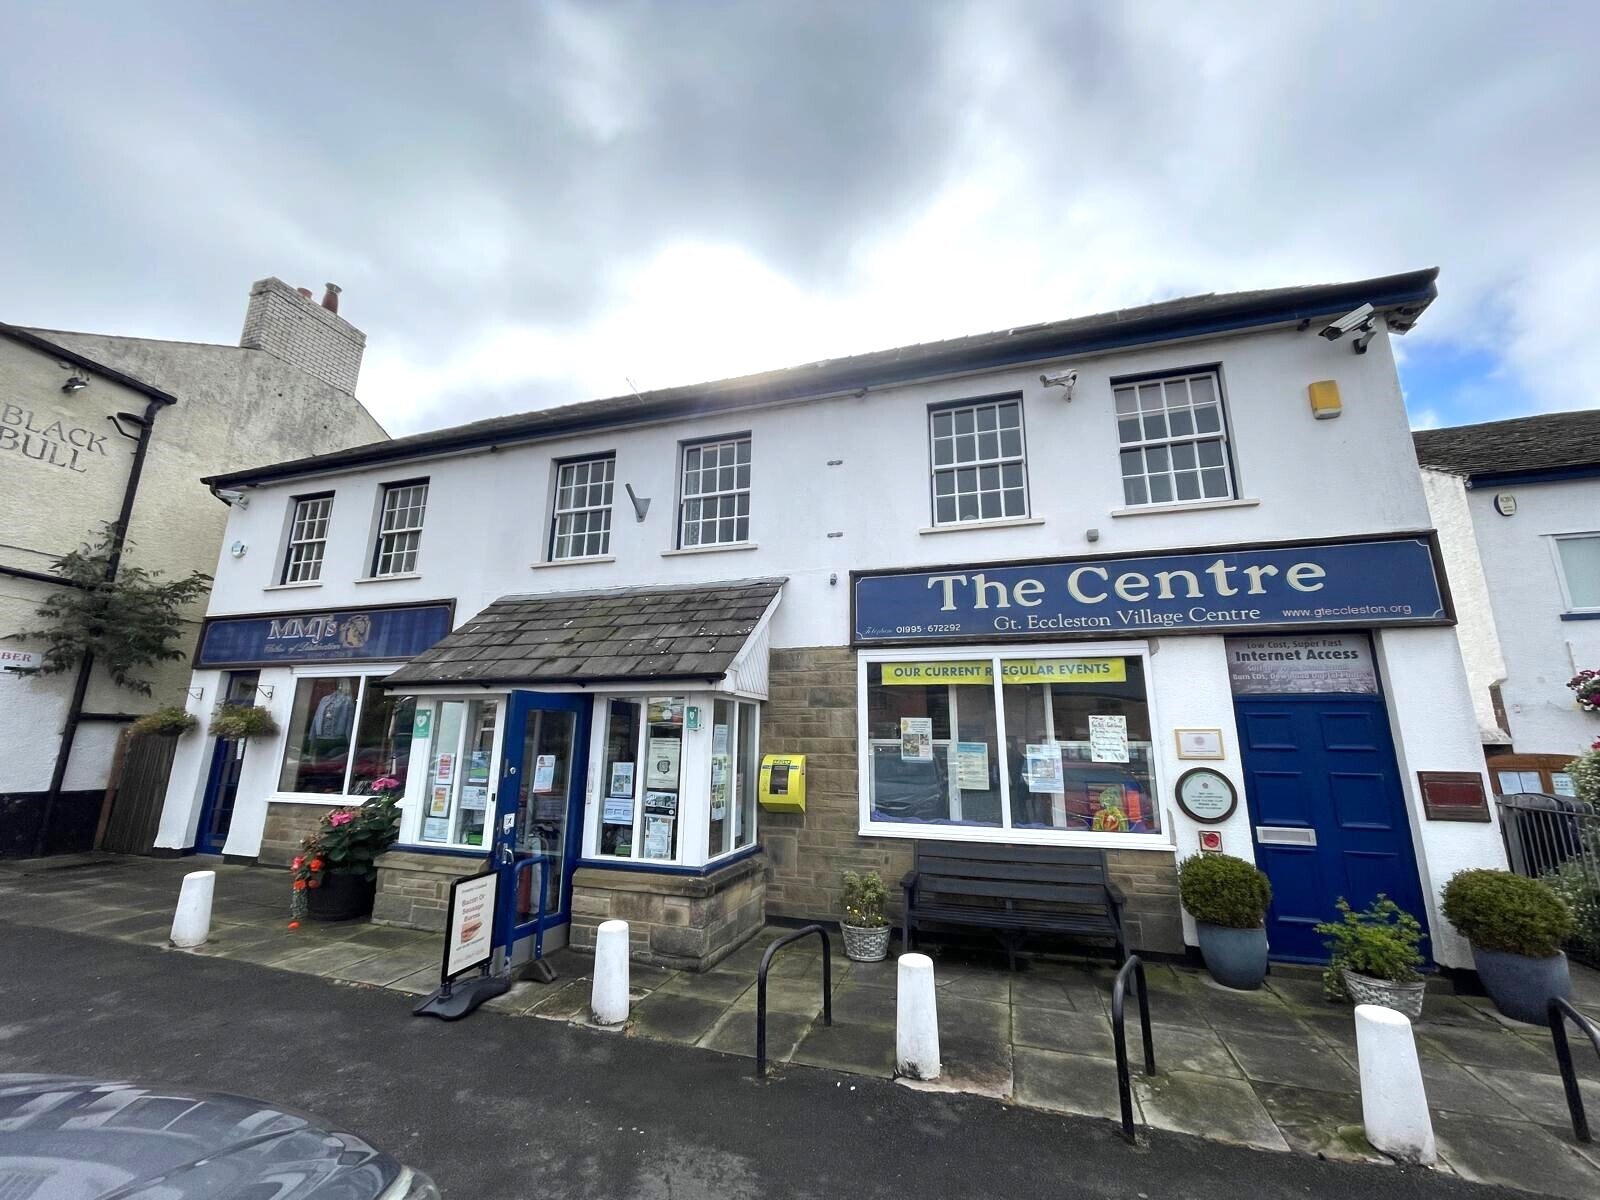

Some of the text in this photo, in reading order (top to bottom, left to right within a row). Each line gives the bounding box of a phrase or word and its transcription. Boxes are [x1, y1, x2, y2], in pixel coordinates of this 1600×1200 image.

[2, 403, 108, 456] BLACK
[0, 426, 87, 473] BULL
[927, 559, 1326, 611] The Centre
[994, 606, 1261, 630] Gt. Eccleston Village Centre
[1235, 649, 1359, 662] Internet Access
[1247, 639, 1342, 650] Low Cost, Super Fast
[894, 667, 920, 678] OUR
[924, 666, 981, 677] CURRENT
[1059, 663, 1111, 675] EVENTS
